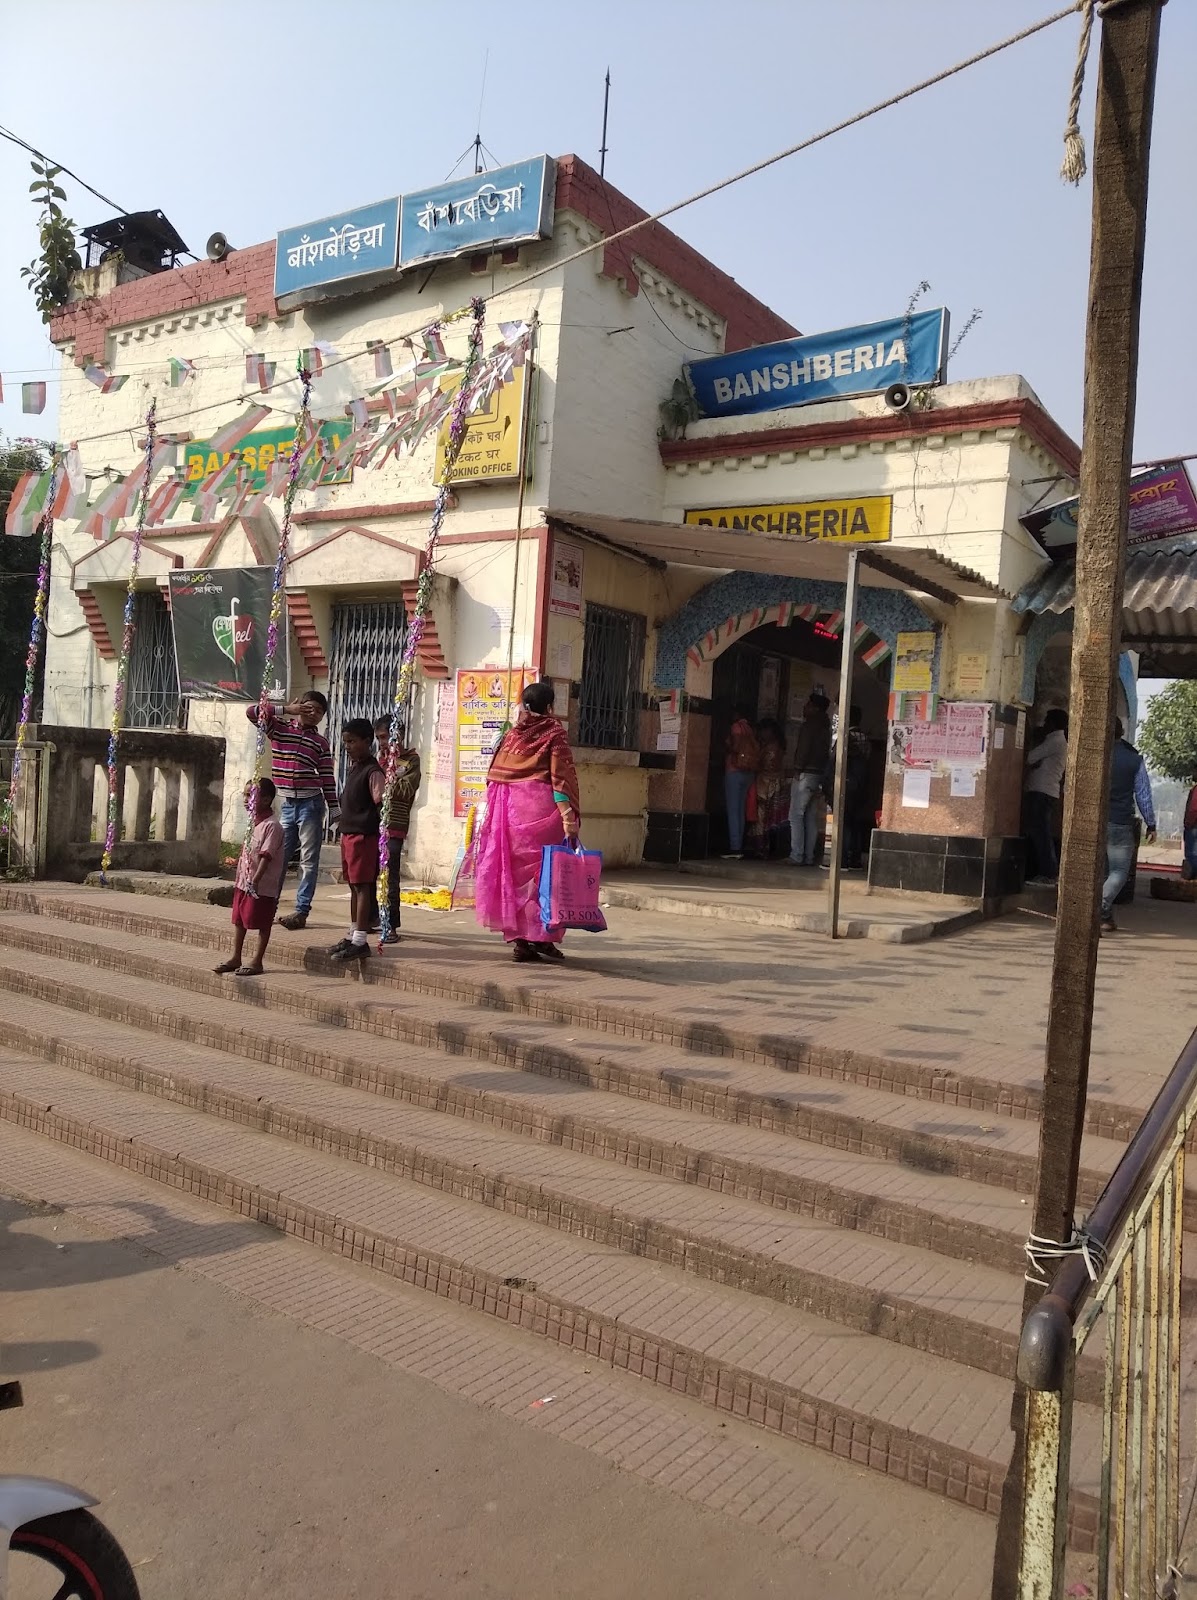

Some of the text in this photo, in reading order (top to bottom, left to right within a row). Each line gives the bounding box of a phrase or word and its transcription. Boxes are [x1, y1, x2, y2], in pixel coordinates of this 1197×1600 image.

[416, 182, 526, 233] বাঁশবেড়িয়া
[287, 222, 386, 268] बाँशबेड़िया
[713, 339, 908, 404] BANSHBERIA
[487, 430, 502, 442] ঘর
[485, 449, 501, 460] घर
[450, 462, 513, 478] OKING OFFICE
[462, 699, 488, 710] বার্ষিক
